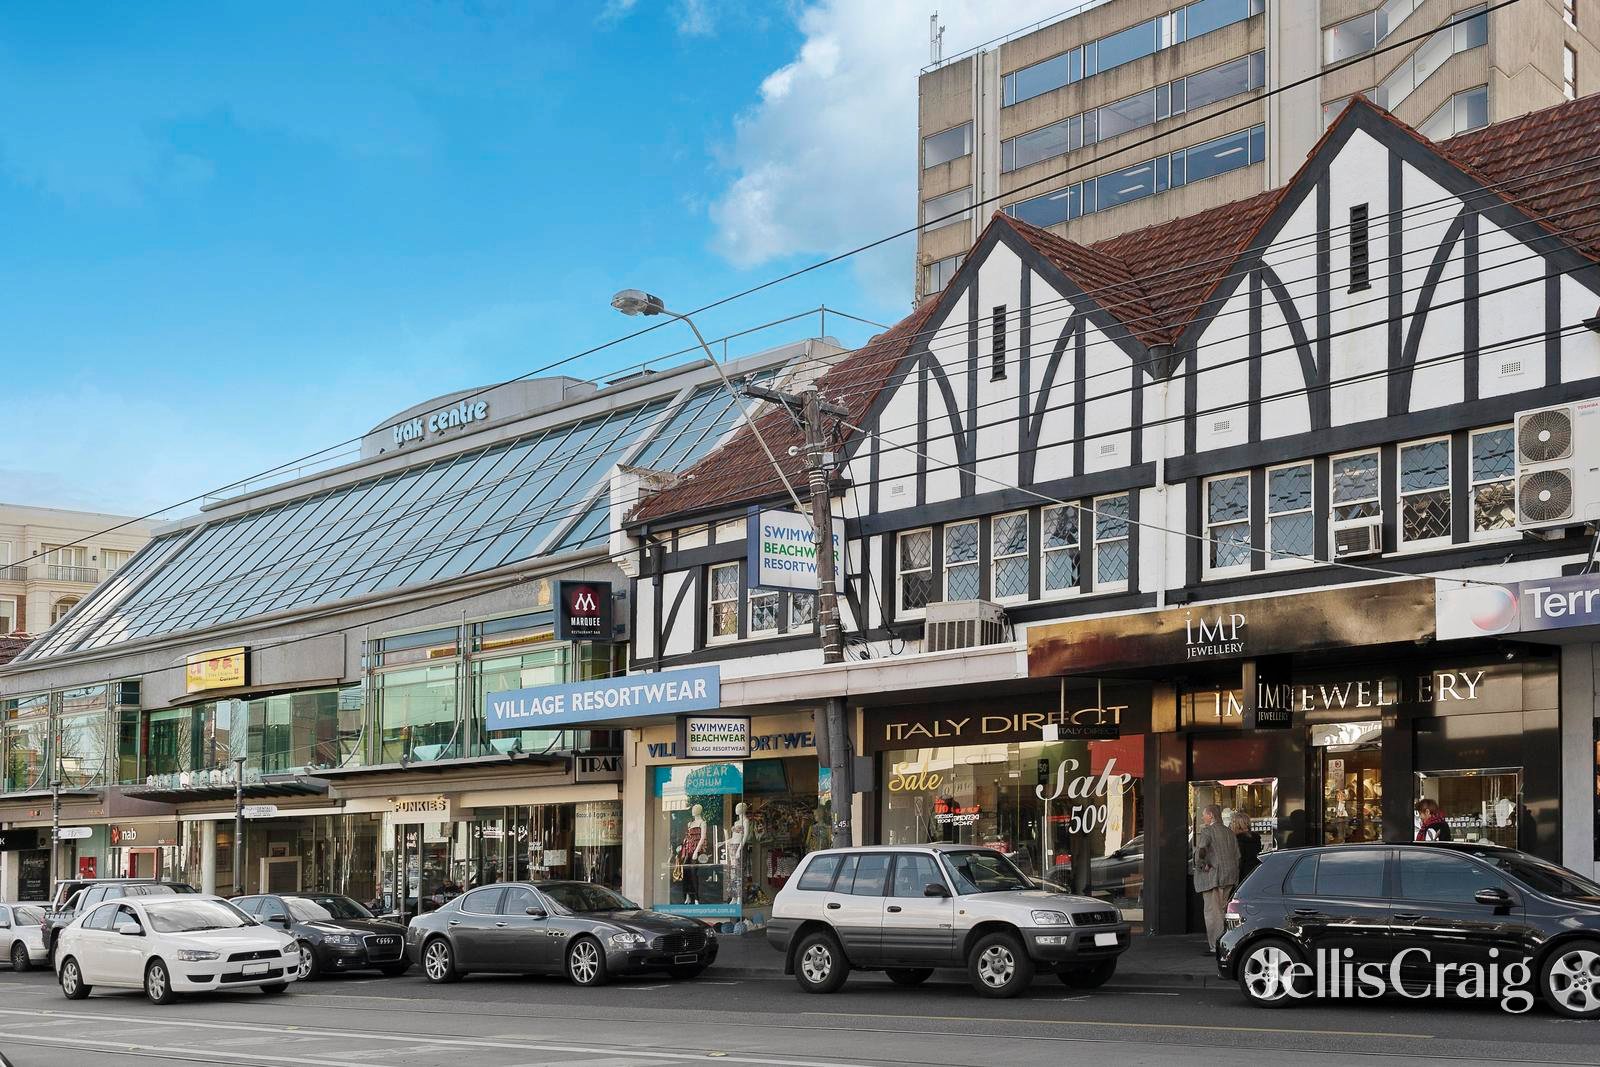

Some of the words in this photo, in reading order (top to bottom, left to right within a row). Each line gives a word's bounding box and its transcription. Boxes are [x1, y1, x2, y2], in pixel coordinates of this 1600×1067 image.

[428, 400, 489, 433] centre
[764, 525, 839, 546] SWIMWR
[764, 541, 839, 561] BEACHWR
[764, 557, 839, 576] RESORTWR
[1524, 586, 1600, 619] Terr
[570, 617, 600, 626] MARQUEE
[1186, 642, 1244, 660] JEWELLERY
[493, 694, 565, 720] VILLAGE
[571, 678, 708, 712] RESORTWEAR
[1286, 670, 1486, 713] JEWELERY
[886, 717, 971, 741] ITALY
[981, 705, 1129, 735] DIRECT
[1258, 711, 1289, 722] JEWELLERY
[690, 723, 746, 732] SWIMWEAR
[647, 742, 676, 758] VILL
[750, 732, 816, 752] ORTWE
[690, 733, 746, 742] BEACHWEAR
[578, 756, 623, 773] TRAK
[687, 778, 723, 788] PORIUM
[888, 761, 944, 792] Sale
[1035, 758, 1137, 801] Sale
[395, 800, 447, 812] FUNKIES
[121, 828, 136, 841] nab
